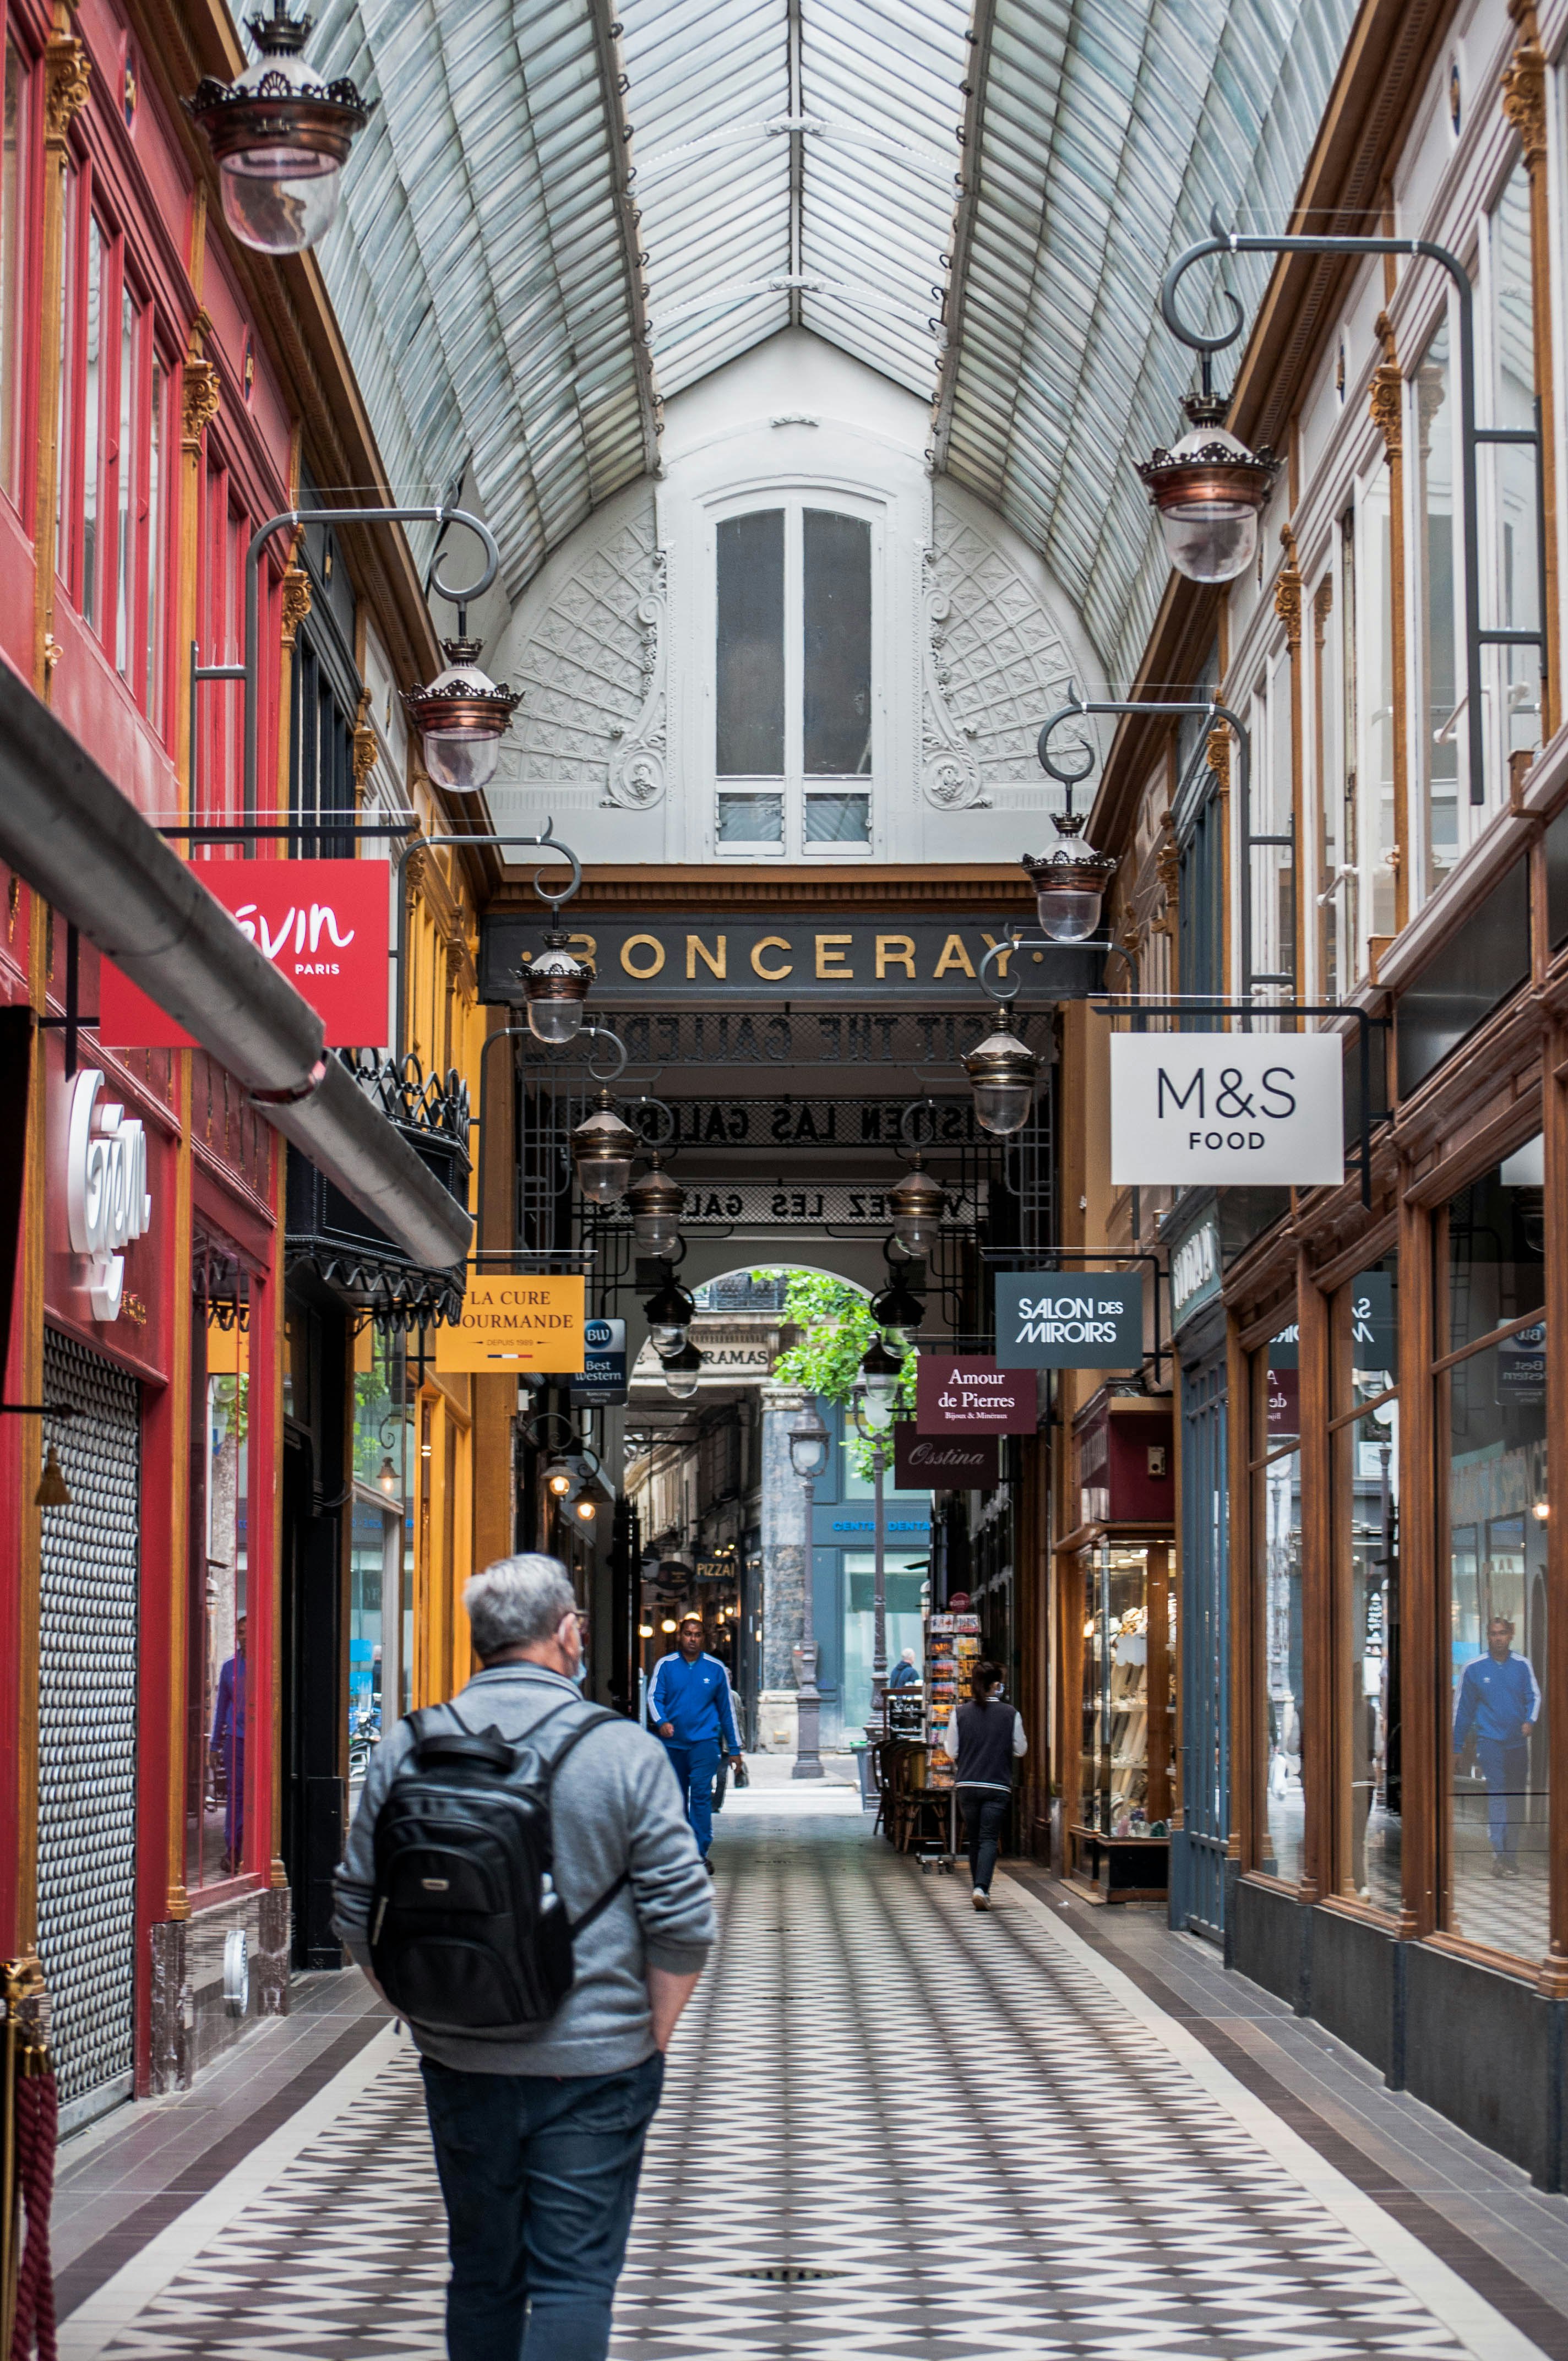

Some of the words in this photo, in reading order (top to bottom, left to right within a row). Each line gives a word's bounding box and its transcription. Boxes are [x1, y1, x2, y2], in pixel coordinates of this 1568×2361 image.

[295, 964, 340, 975] PARIS
[1157, 1067, 1296, 1119] M&S
[1189, 1132, 1265, 1150] FOOD
[471, 1291, 493, 1304] LA
[500, 1291, 551, 1304] CURE
[1019, 1298, 1093, 1319] SALON
[1097, 1301, 1124, 1314] DES
[461, 1314, 574, 1328] OURMANDE
[587, 1329, 609, 1341] BW
[1015, 1321, 1117, 1342] MIROIRS
[586, 1360, 612, 1371] Best
[575, 1372, 622, 1381] Western
[948, 1369, 1005, 1384] Amour
[938, 1392, 958, 1407] de
[961, 1392, 1015, 1407] Pierres
[945, 1411, 966, 1421] Bijoux
[909, 1443, 985, 1466] Osstina
[832, 1521, 876, 1532] CENTR
